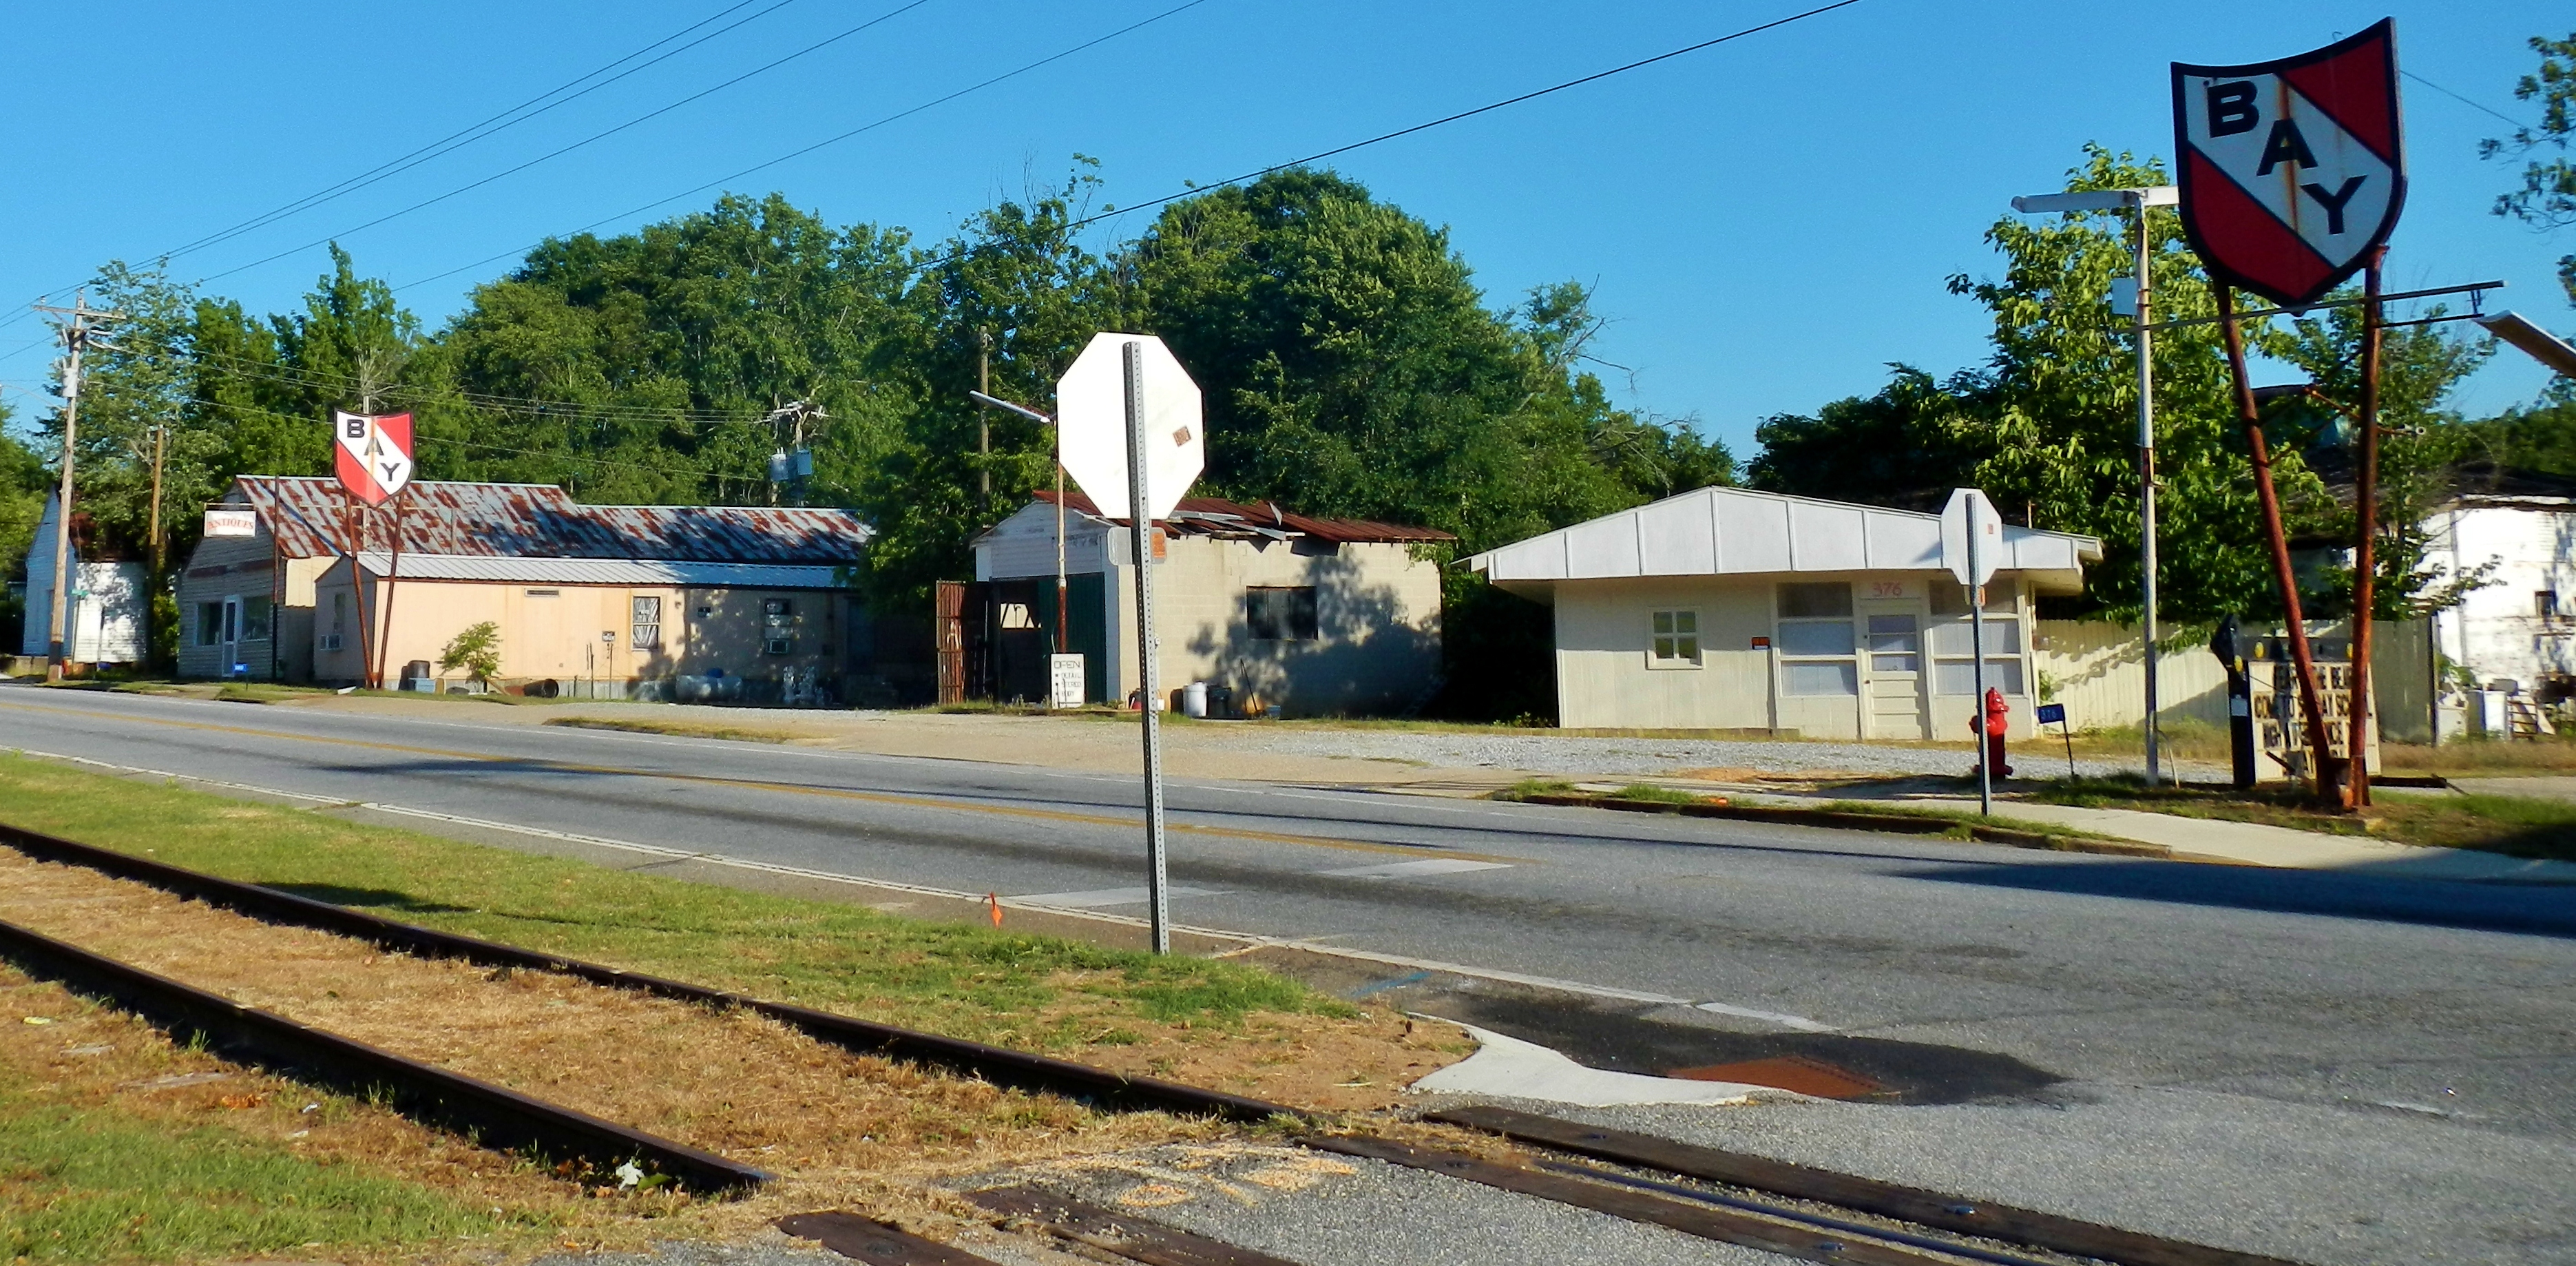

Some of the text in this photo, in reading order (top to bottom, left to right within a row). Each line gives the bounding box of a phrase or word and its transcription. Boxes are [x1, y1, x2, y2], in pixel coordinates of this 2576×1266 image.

[2207, 80, 2369, 235] BAY
[346, 419, 401, 481] BAY
[207, 518, 253, 530] ANTIQUES
[1873, 582, 1902, 596] 376
[1054, 661, 1080, 669] OPEN
